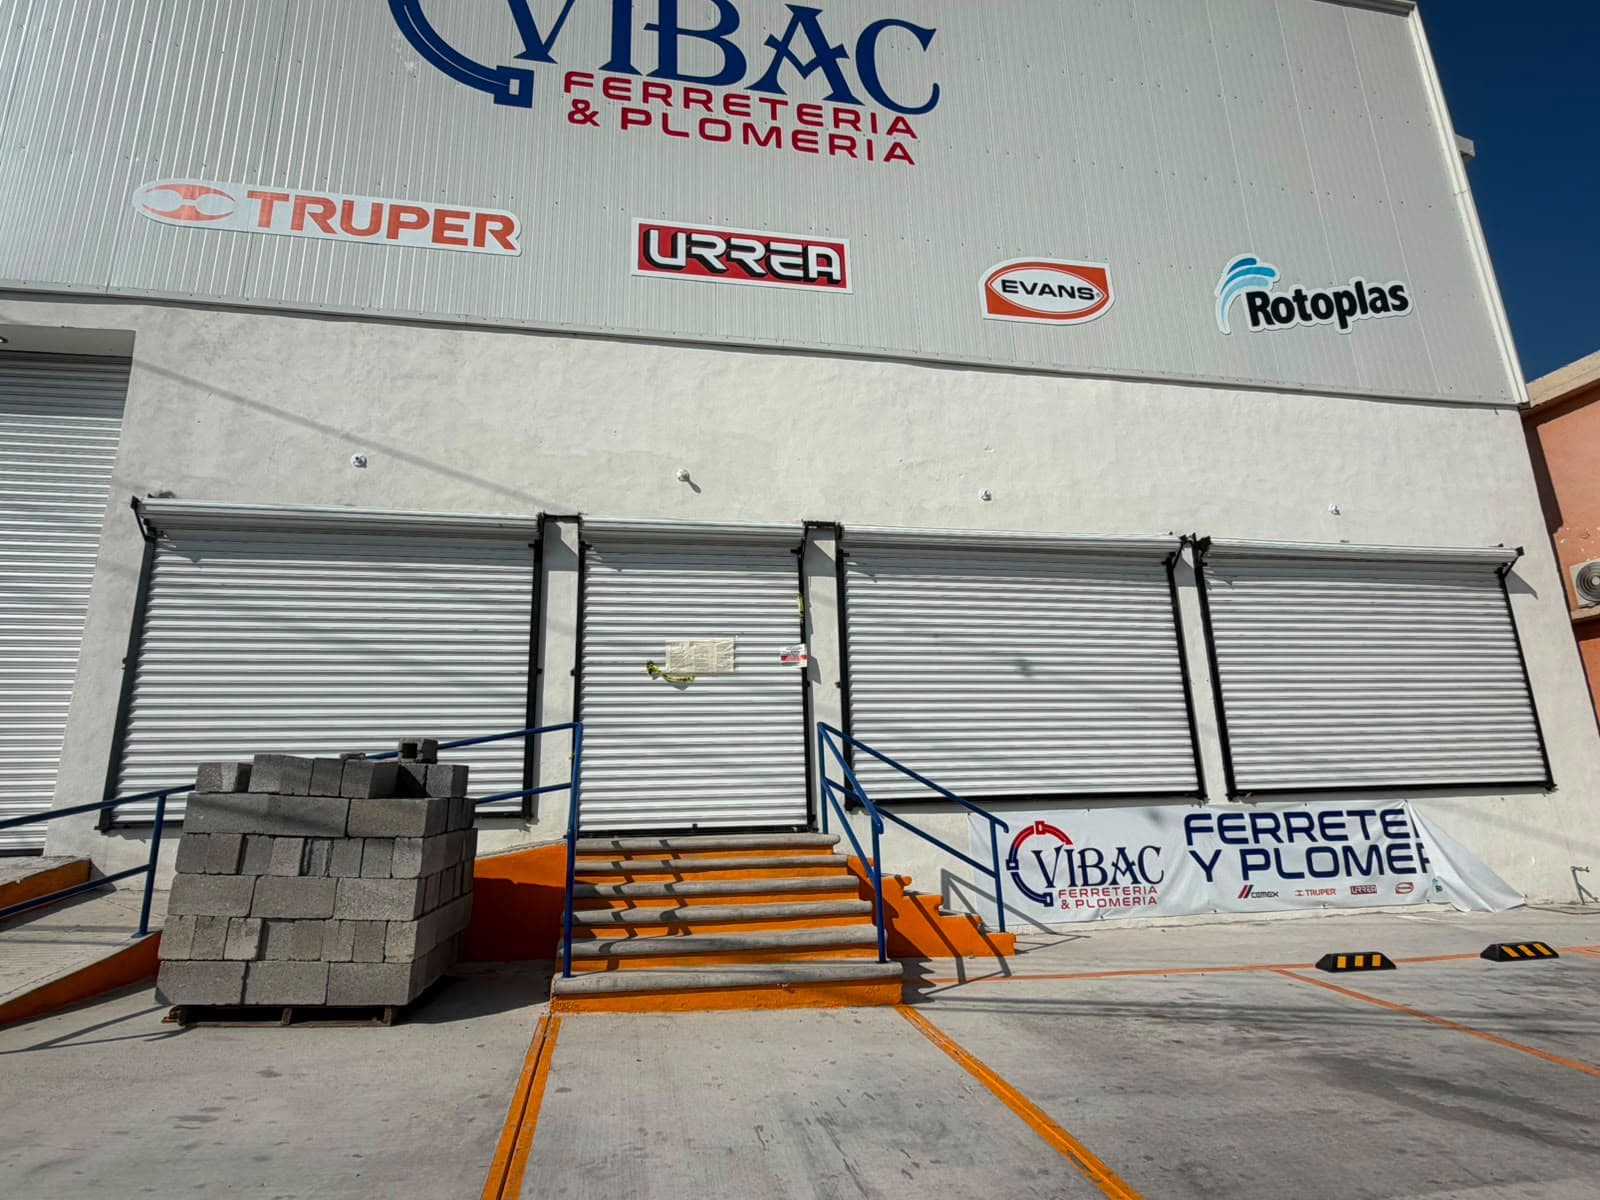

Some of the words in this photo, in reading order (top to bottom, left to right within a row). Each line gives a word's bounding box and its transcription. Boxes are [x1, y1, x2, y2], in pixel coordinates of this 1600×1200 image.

[508, 0, 940, 116] VIBAC
[563, 70, 918, 139] FERRETERIA
[567, 98, 601, 127] &
[620, 106, 916, 166] PLOMERIA
[246, 190, 517, 250] TRUPER
[643, 227, 842, 284] URREA
[1001, 279, 1095, 301] EVANS
[1246, 280, 1410, 330] Rotoplas
[1184, 808, 1420, 846] FERRETE
[1031, 844, 1164, 888] VIBAC
[1188, 849, 1221, 882] Y
[1058, 886, 1157, 899] FERRETERIA
[1061, 899, 1070, 910] &
[1075, 896, 1157, 909] PLOMERIA
[1305, 888, 1336, 896] TRUPER
